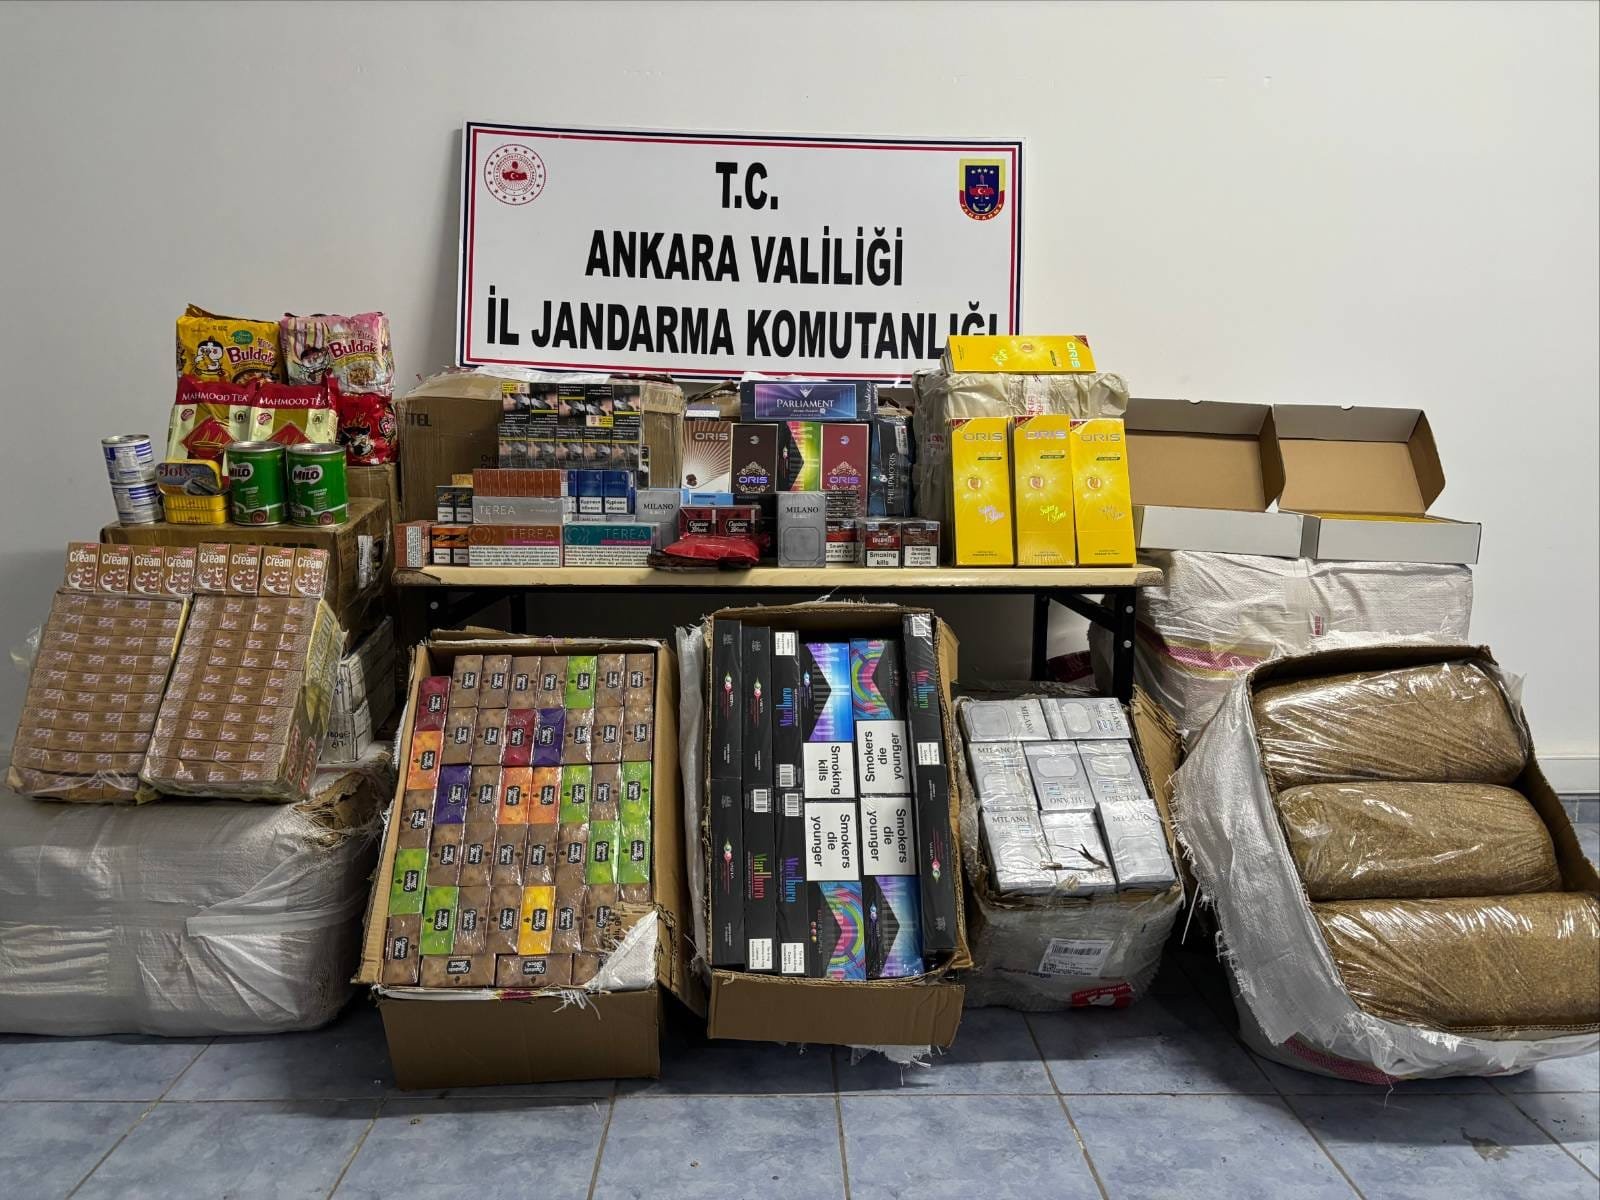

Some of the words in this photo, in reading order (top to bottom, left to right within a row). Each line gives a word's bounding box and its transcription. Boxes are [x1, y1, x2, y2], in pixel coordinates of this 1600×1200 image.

[715, 162, 779, 212] T.C.
[584, 229, 740, 283] ANKARA
[751, 226, 904, 287] VALİLİĞİ
[486, 286, 520, 346] İL
[531, 300, 735, 357] JANDARMA
[226, 347, 274, 364] Buldak
[329, 340, 376, 359] Buldak
[1067, 342, 1080, 368] ORIS
[182, 393, 230, 401] MAHMOOD
[232, 394, 247, 402] TEA
[260, 397, 308, 406] MAHMOOD
[310, 397, 326, 407] TEA
[777, 399, 834, 408] PARLIAMENT
[695, 432, 728, 440] ORIS
[963, 432, 1003, 442] ORIS
[1025, 430, 1066, 440] ORIS
[1081, 433, 1121, 443] ORIS
[294, 470, 320, 481] MILO
[739, 476, 768, 484] ORIS
[829, 476, 859, 484] ORIS
[479, 505, 516, 515] TEREA
[512, 528, 554, 538] TEREA
[604, 528, 647, 539] TEREA
[69, 551, 96, 563] Cream
[102, 553, 129, 565] Cream
[135, 555, 161, 567] Cream
[167, 556, 193, 568] Cream
[200, 552, 226, 564] Cream
[232, 554, 257, 565] Cream
[265, 555, 291, 567] Cream
[297, 557, 323, 569] Cream
[776, 688, 793, 727] Marlboro
[865, 731, 875, 782] Smokers
[878, 747, 888, 765] die
[892, 733, 904, 780] younger
[818, 759, 829, 782] kills
[831, 745, 842, 795] Smoking
[991, 816, 1029, 824] MILANO
[811, 816, 822, 867] younger
[827, 831, 838, 851] die
[840, 814, 851, 869] Smokers
[867, 811, 879, 862] younger
[884, 826, 894, 845] die
[896, 808, 908, 864] Smokers
[753, 853, 772, 899] Marlboro
[784, 857, 803, 903] Marlboro
